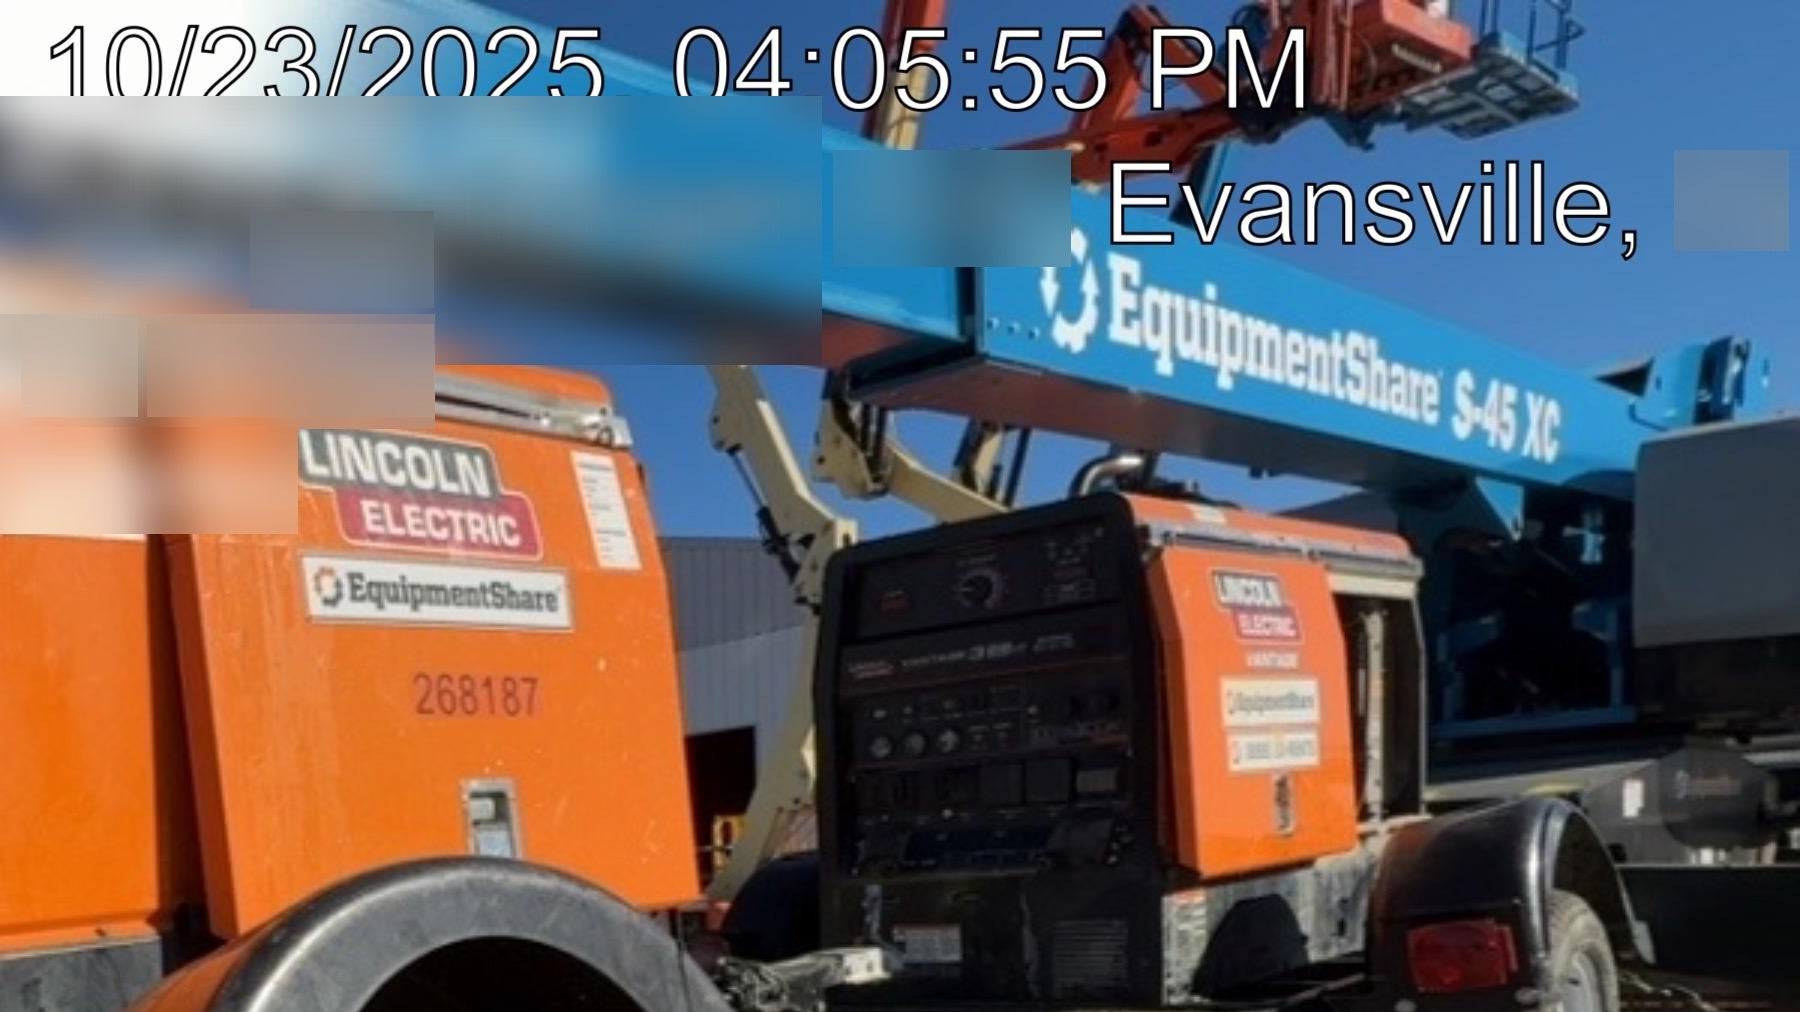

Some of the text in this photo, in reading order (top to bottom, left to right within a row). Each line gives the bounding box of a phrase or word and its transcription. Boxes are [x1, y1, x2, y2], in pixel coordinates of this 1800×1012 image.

[1107, 253, 1561, 463] EquipmentShare S-45 XC
[301, 430, 491, 496] LINCOLN
[360, 500, 521, 547] ELECTRIC
[348, 572, 559, 612] EquipmentShare
[413, 673, 538, 716] 268187
